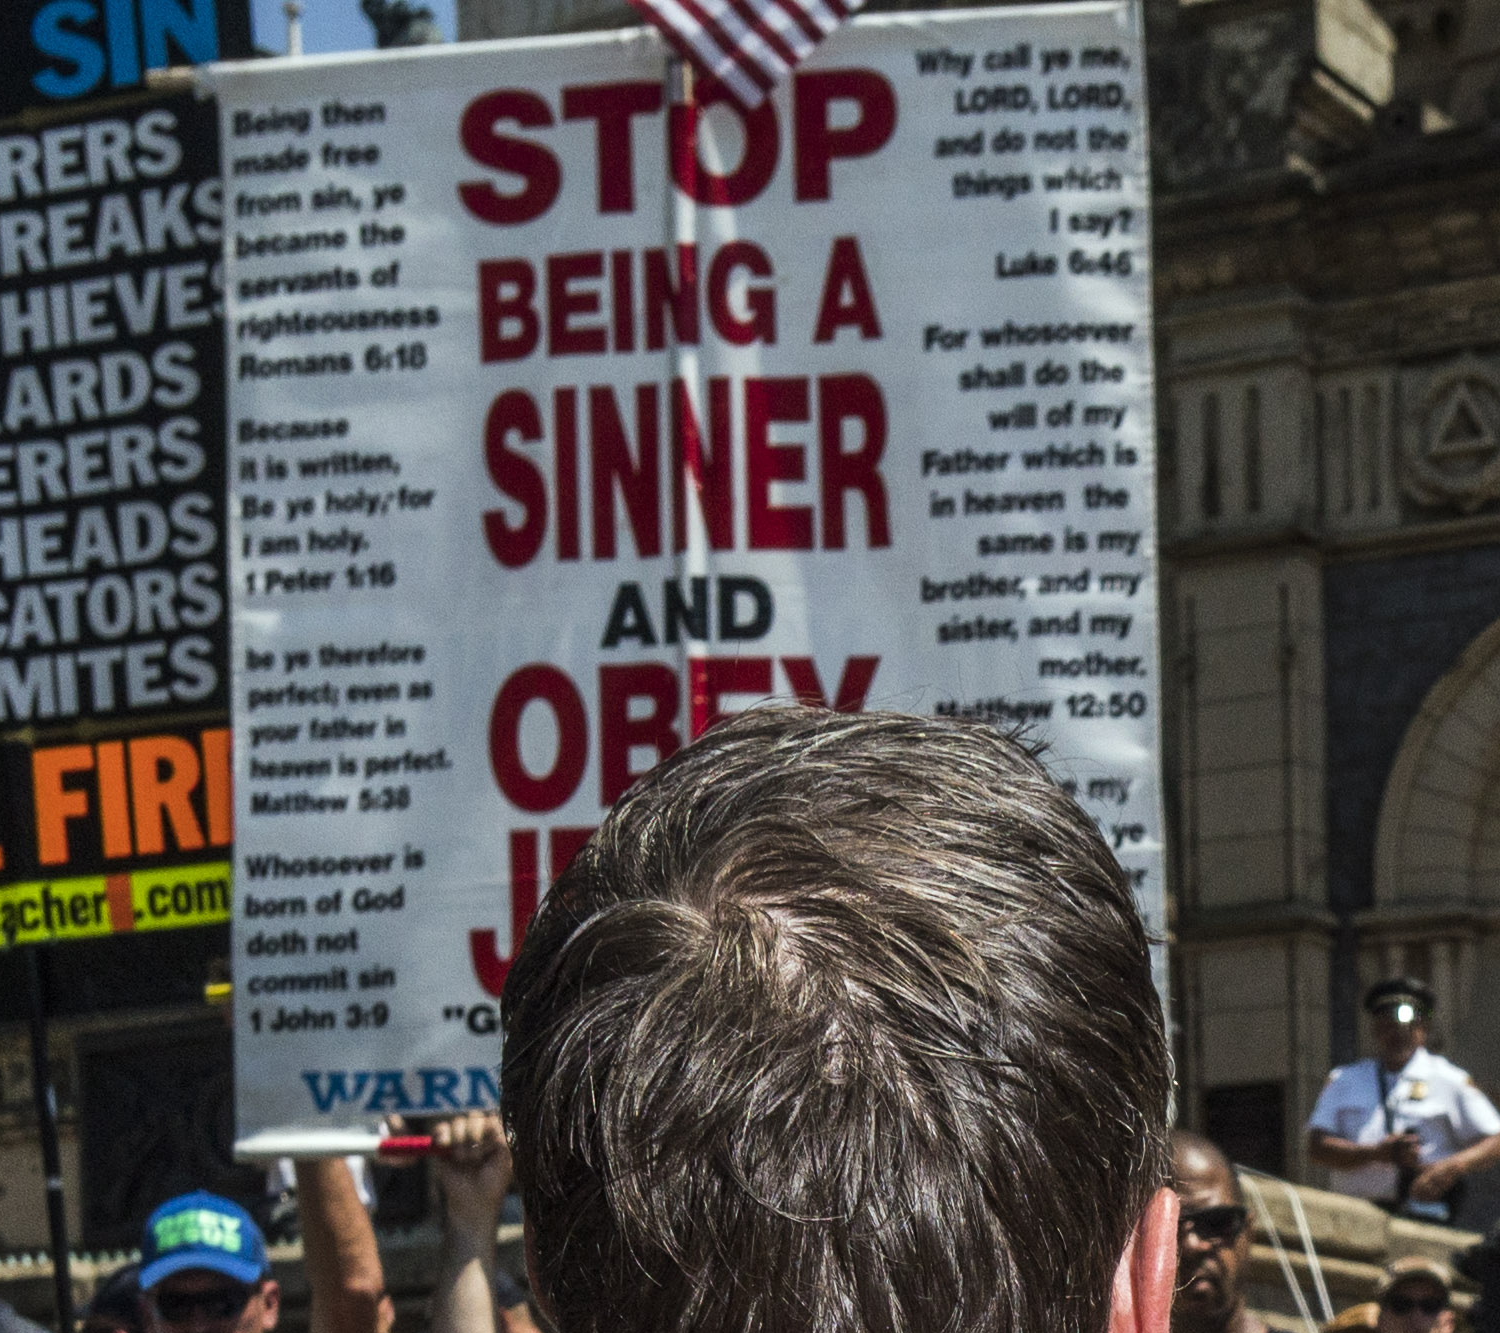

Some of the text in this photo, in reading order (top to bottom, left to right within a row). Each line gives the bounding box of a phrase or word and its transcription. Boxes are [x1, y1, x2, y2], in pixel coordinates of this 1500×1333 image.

[30, 0, 220, 98] SIN
[915, 48, 974, 79] Why
[983, 42, 1032, 72] call
[1040, 48, 1073, 75] ye
[231, 101, 386, 139] Being then
[457, 67, 899, 227] STOP
[934, 126, 1130, 159] and do not the
[231, 142, 381, 178] made free
[951, 165, 1123, 201] things which
[233, 190, 303, 219] from
[372, 183, 406, 212] ye
[1048, 206, 1136, 238] I say?
[234, 221, 406, 262] became the
[236, 260, 401, 302] servants of
[995, 251, 1058, 280] Luke
[478, 236, 883, 365] BEING A
[235, 306, 442, 345] righteousness
[922, 320, 1134, 352] For whosoever
[236, 353, 354, 383] Romans
[958, 358, 1125, 392] shall do the
[235, 417, 349, 446] Because
[987, 400, 1126, 431] will of my
[238, 458, 258, 482] it
[264, 456, 289, 481] is
[481, 372, 893, 568] SINNER
[920, 441, 1139, 478] Father which is
[241, 494, 275, 522] Be
[286, 496, 315, 523] ye
[394, 485, 436, 510] for
[929, 483, 1130, 519] in heaven the
[259, 535, 301, 557] am
[976, 528, 1142, 558] same is my
[245, 571, 257, 598] 1
[264, 569, 336, 595] Peter
[1037, 566, 1093, 595] and
[1097, 570, 1146, 598] my
[600, 574, 775, 650] AND
[1026, 610, 1082, 638] and
[1088, 614, 1133, 640] my
[283, 650, 311, 674] ye
[317, 641, 426, 668] therefore
[1037, 650, 1148, 678] mother.
[345, 683, 401, 704] even
[407, 681, 434, 700] as
[1066, 690, 1147, 719] 12:50
[249, 724, 301, 749] your
[384, 716, 407, 738] in
[249, 757, 332, 780] heaven
[338, 755, 358, 776] is
[249, 791, 348, 817] Matthew
[244, 846, 426, 881] Whosoever is
[242, 885, 406, 920] born of God
[245, 929, 359, 958] doth not
[246, 966, 396, 997] commit sin
[249, 1002, 390, 1034] 1 John 3:9
